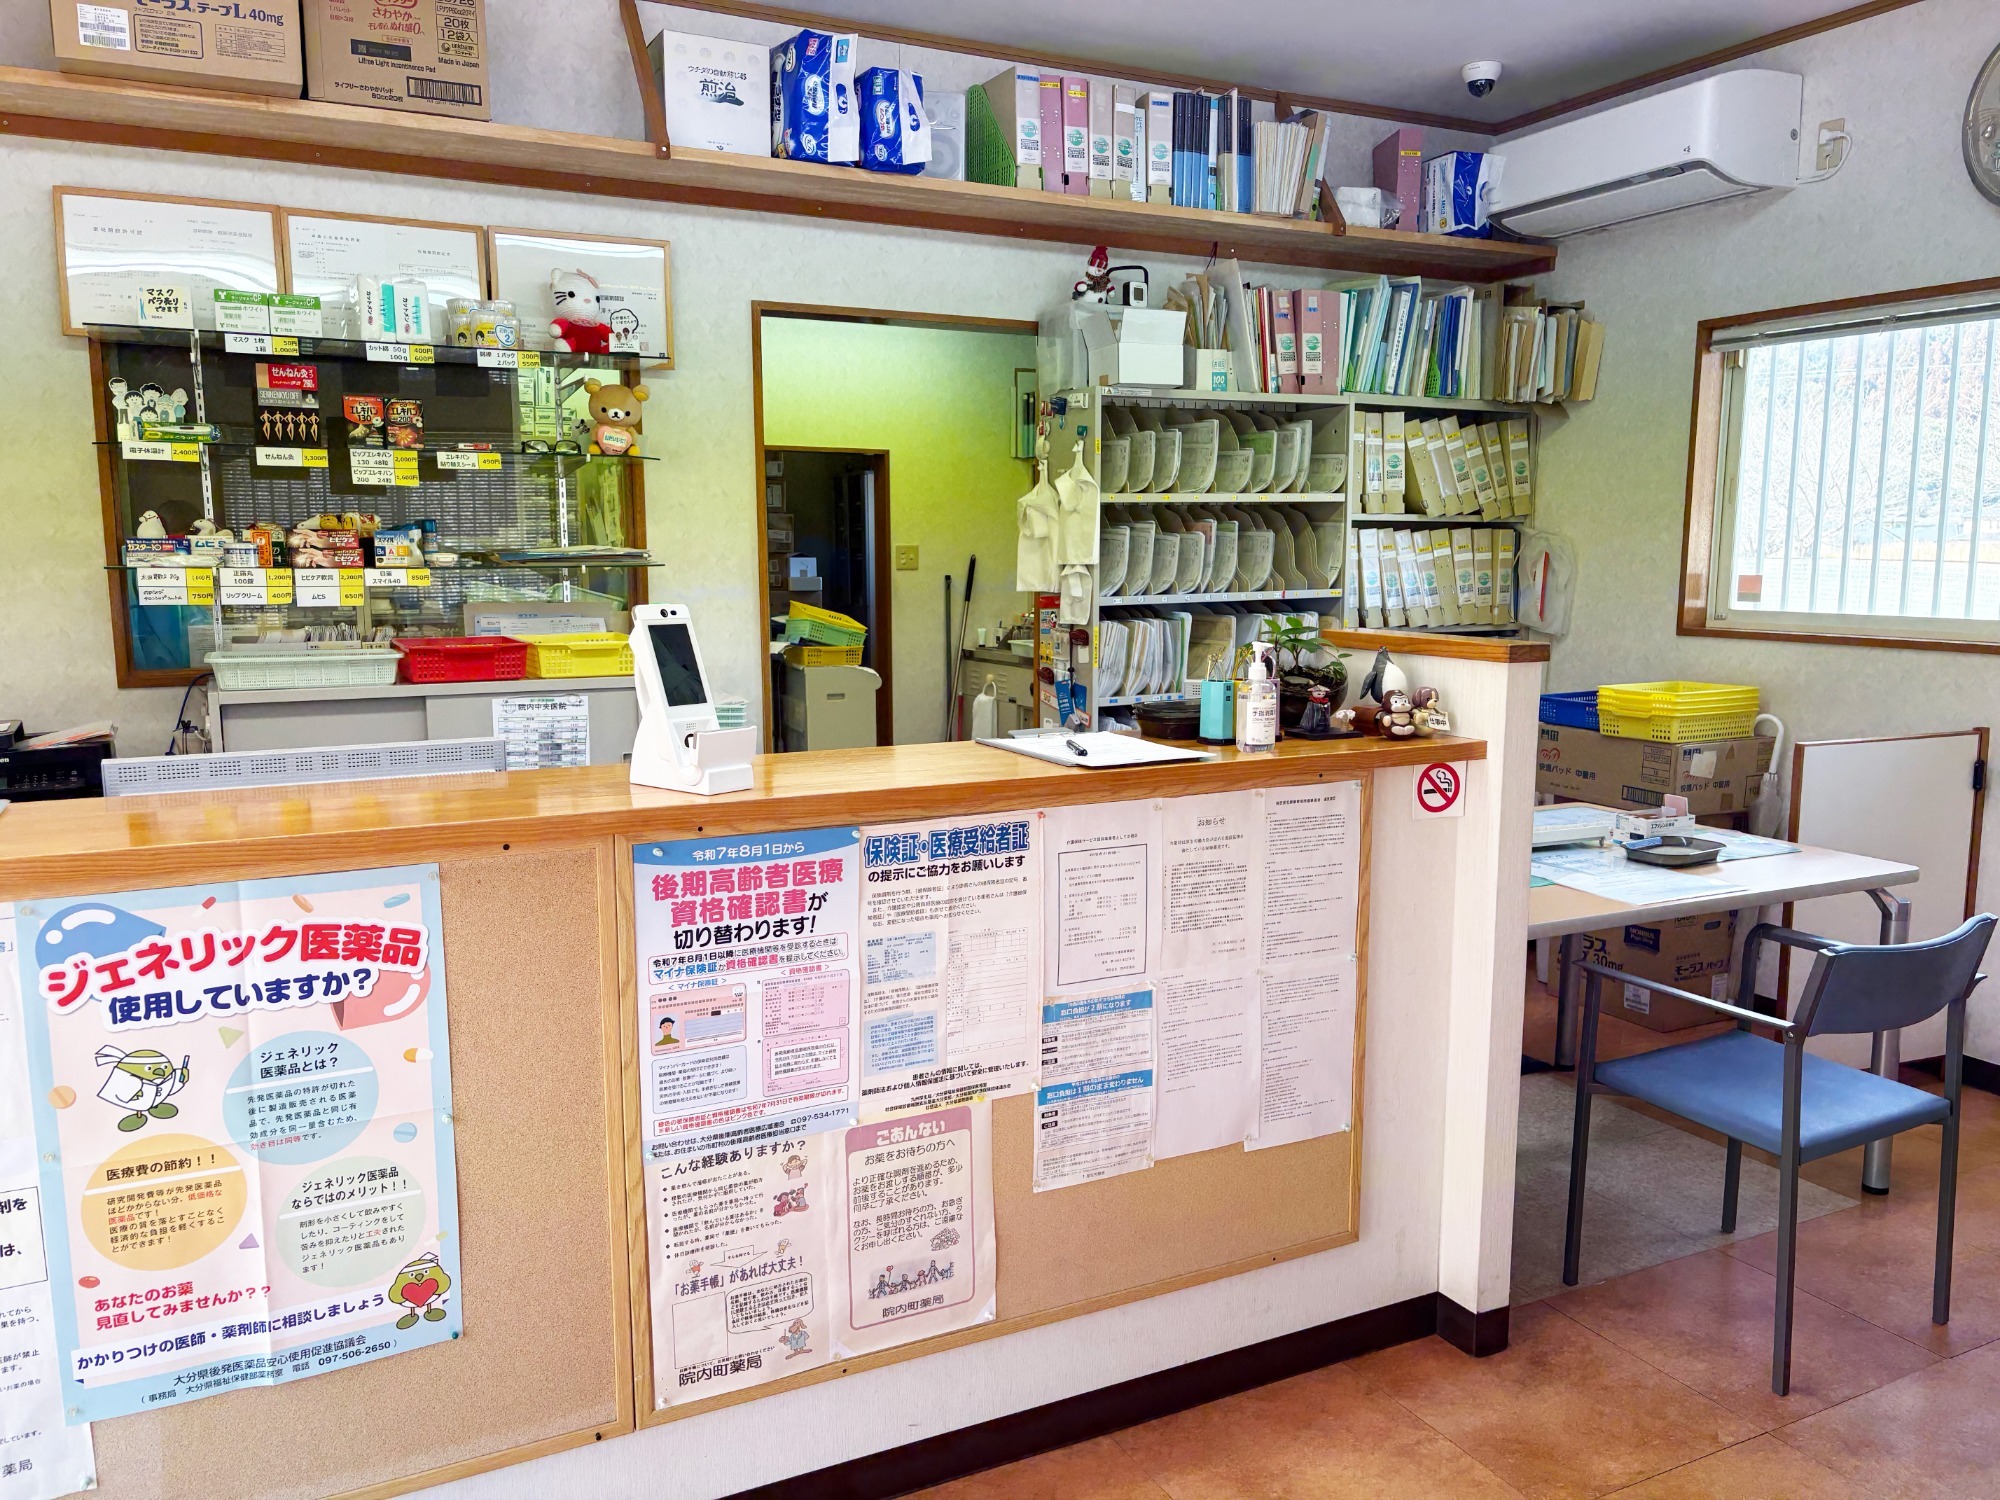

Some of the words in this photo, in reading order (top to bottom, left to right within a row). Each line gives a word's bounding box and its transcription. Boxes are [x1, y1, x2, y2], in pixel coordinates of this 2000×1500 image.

[249, 9, 284, 26] 40mg
[372, 7, 413, 22] さわやか
[443, 17, 470, 30] 20枚
[440, 29, 475, 42] 12袋入
[438, 56, 452, 65] Made
[146, 288, 174, 297] マスク
[254, 337, 265, 345] 1枚
[271, 366, 308, 378] せんねん灸
[350, 406, 378, 415] エレキバン
[357, 414, 372, 422] 130
[264, 453, 295, 461] せんねん灸
[1539, 762, 1571, 775] 快適パッド
[1680, 781, 1709, 793] 快適パッド
[1198, 817, 1225, 827] お知らせ
[692, 842, 805, 861] 令和7年8月1日から
[864, 821, 1030, 868] 保険証・医療受給者証
[651, 858, 844, 901] 後期高齢者医療
[868, 855, 1026, 883] の提示にご協力をお願いします
[670, 889, 828, 928] 資格確認書が
[673, 915, 817, 950] 切り替わります!
[48, 923, 421, 1008] ジェネリック医薬品
[653, 949, 845, 979] マイナ保険証か資格確認書を提示してください。
[1674, 962, 1704, 977] モーラス
[108, 968, 372, 1024] 使用していますか？
[260, 1042, 339, 1063] ジェネリック
[260, 1057, 339, 1079] 医薬品とは？
[247, 1079, 356, 1104] 先発医薬品の特許が切れた
[248, 1091, 357, 1116] 後に製造販売される医薬
[249, 1103, 357, 1128] 品で、先発医薬品と同じ有
[250, 1114, 358, 1139] 効成分を同一量含むため、
[876, 1120, 945, 1146] ごあんない
[661, 1140, 806, 1179] こんな経験ありますか？
[864, 1139, 955, 1166] お薬をお待ちの方へ
[106, 1153, 215, 1181] 医療費の節約！！
[302, 1166, 399, 1193] ジェネリック医薬品
[853, 1157, 958, 1187] より正確な調剤を進めるため、
[853, 1164, 963, 1195] お薬をお渡しする順番が、多少
[107, 1179, 223, 1206] 研究開発費等が先発医薬品
[107, 1189, 223, 1215] ほどかからない分、低価格な
[291, 1179, 407, 1210] ならではのメリット！！
[853, 1178, 944, 1204] 前後することがあります。
[854, 1190, 928, 1214] 何卒ご了承ください。
[108, 1209, 160, 1225] 医薬品です！
[109, 1207, 223, 1235] 医療の質を落とすことなく
[300, 1203, 403, 1228] 剤形を小さくして飲みやすく
[301, 1213, 404, 1240] したり、コーティングをして
[853, 1205, 963, 1236] の方、ご気分のすぐれない方、タ
[110, 1216, 225, 1245] 経済的な負担を軽くするこ
[300, 1224, 405, 1251] 苦みを抑えたりと工夫された
[854, 1214, 963, 1244] クシーを呼ばれる方は、ご遠慮な
[854, 1230, 923, 1252] くお申し出ください。
[112, 1235, 173, 1253] とができます！
[301, 1235, 405, 1262] ジェネリック医薬品もあり
[302, 1262, 324, 1273] ます！
[95, 1281, 193, 1312] あなたのお薬
[96, 1285, 271, 1330] 見直してみませんか？？
[882, 1294, 944, 1319] 院内町薬局
[77, 1293, 384, 1370] かかりつけの医師・薬剤師に相談しましょう
[173, 1334, 367, 1387] 大分県後発医薬品安心使用促進協議会
[292, 1363, 310, 1374] 電話
[679, 1355, 762, 1387] 院内町薬局
[3, 1459, 33, 1478] 薬局
